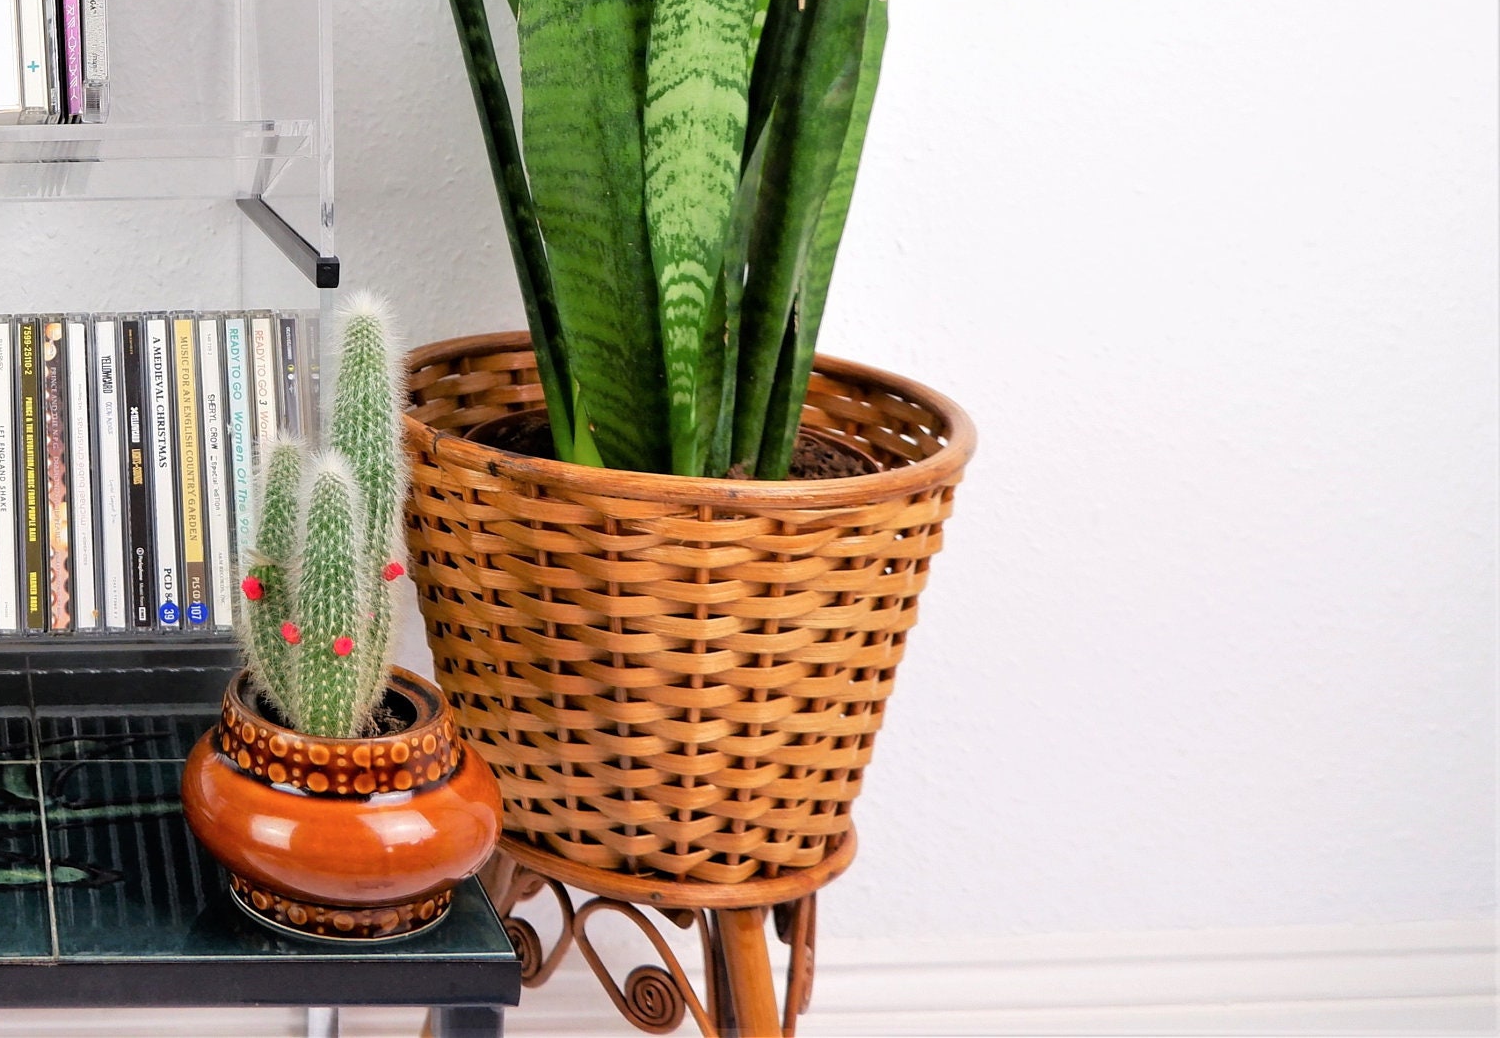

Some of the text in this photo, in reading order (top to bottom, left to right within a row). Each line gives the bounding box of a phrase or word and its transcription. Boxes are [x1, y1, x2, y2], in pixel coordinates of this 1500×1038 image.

[23, 326, 33, 375] 7599-25110-2
[152, 336, 167, 468] A MEDIEVAL CHRISTMAS
[207, 394, 218, 450] SHERYL CROW
[229, 328, 249, 513] READY TO GO Women Of The
[180, 336, 198, 542] MUSIC FOR AN ENGLISH COUNTRY GARDEN
[163, 568, 173, 590] PCD
[164, 608, 174, 621] 39
[191, 605, 202, 620] 107
